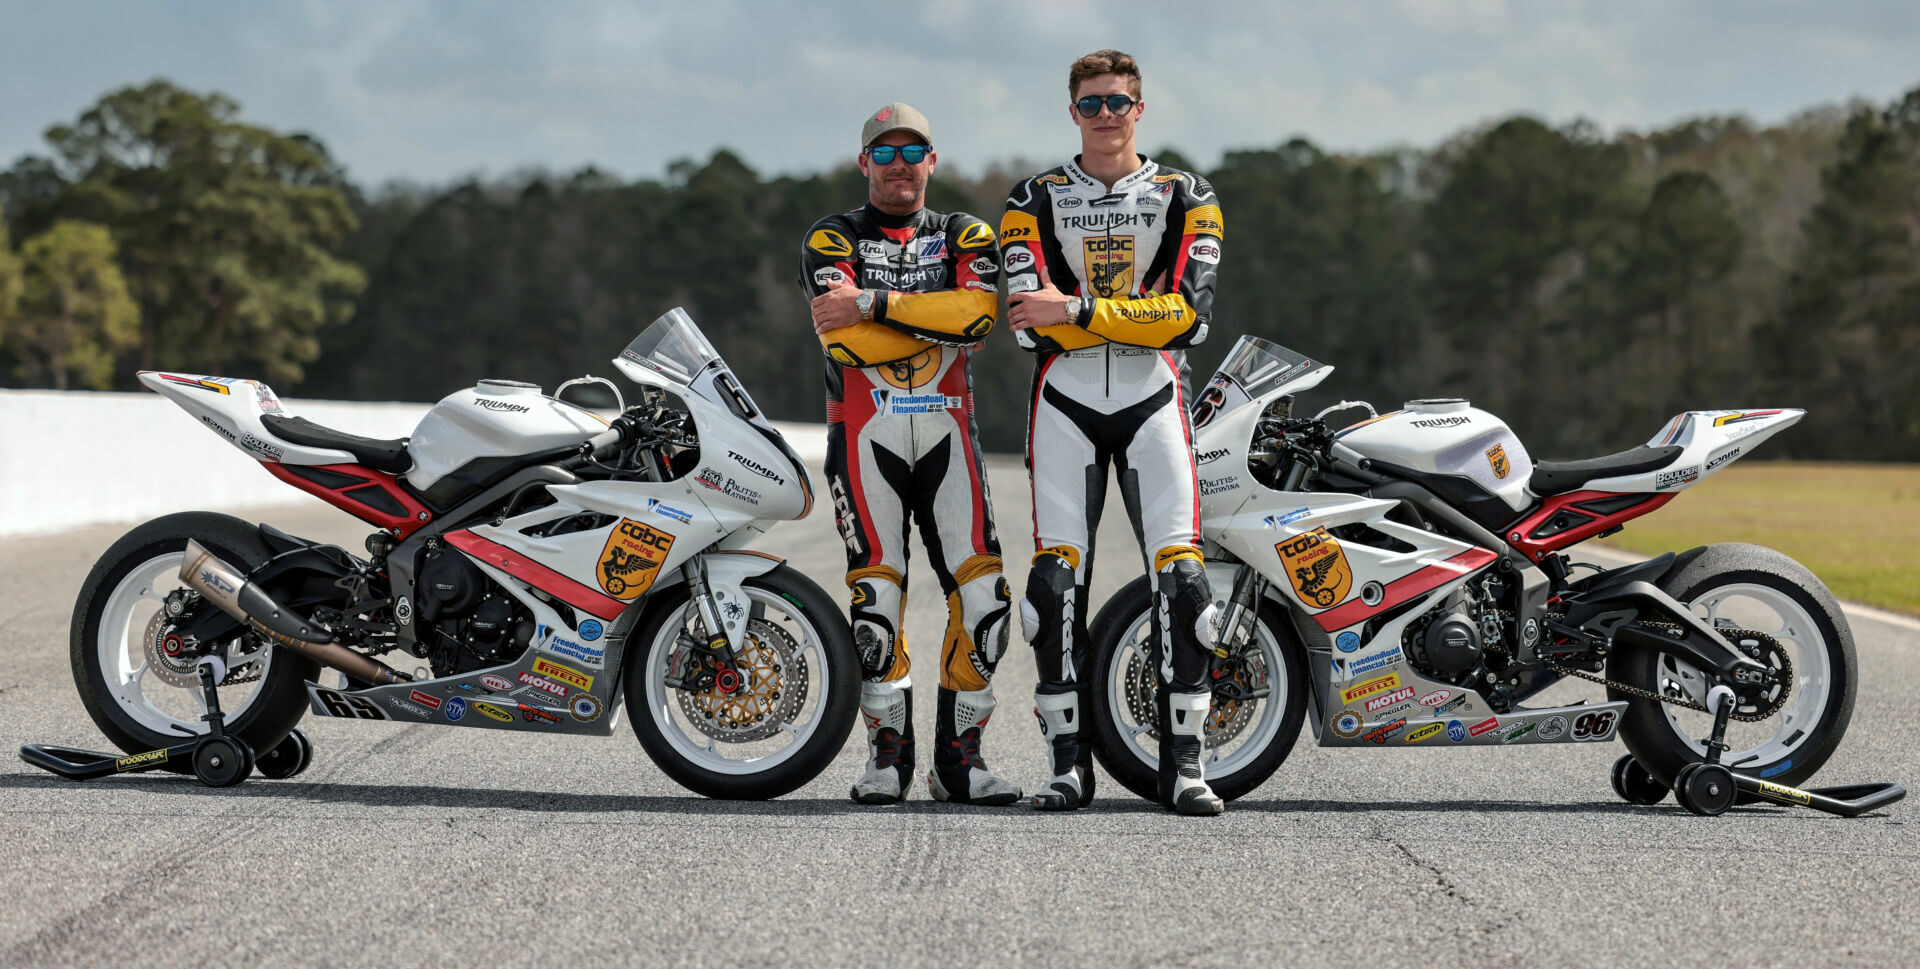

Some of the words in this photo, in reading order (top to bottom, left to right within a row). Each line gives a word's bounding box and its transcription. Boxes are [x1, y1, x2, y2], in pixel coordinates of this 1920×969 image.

[1063, 165, 1094, 187] SPIDI
[1062, 213, 1138, 231] TRIUMPH
[1191, 245, 1219, 259] 166
[866, 268, 927, 289] TRIUMPH
[1115, 308, 1171, 324] TRIUMPH
[473, 398, 531, 413] TRIUMPH
[892, 395, 943, 405] FreedomRoad
[892, 405, 927, 413] Financial
[1410, 417, 1471, 428] TRIUMPH
[243, 432, 284, 456] BOULDER
[728, 450, 785, 486] TRIUMPH
[1657, 466, 1699, 483] BOULDER
[726, 478, 758, 498] POLITIS
[1199, 477, 1234, 490] POLITIS
[1200, 484, 1240, 496] MATOVINA
[722, 487, 758, 506] MATOVINA
[622, 539, 655, 558] racing
[1297, 546, 1329, 564] racing
[550, 643, 586, 663] Financial
[553, 635, 604, 657] FreedomRoad
[1349, 646, 1401, 670] FreedomRoad
[537, 661, 589, 688] PIRELLI
[1351, 660, 1386, 677] Financial
[520, 674, 566, 696] MOTUL
[1346, 677, 1395, 700] PIRELLI
[522, 690, 561, 706] SPIEGLER
[1368, 689, 1415, 711] MOTUL
[447, 702, 465, 716] STM
[1374, 703, 1411, 721] SPIEGLER
[1448, 724, 1465, 738] STM
[1572, 711, 1617, 738] 96
